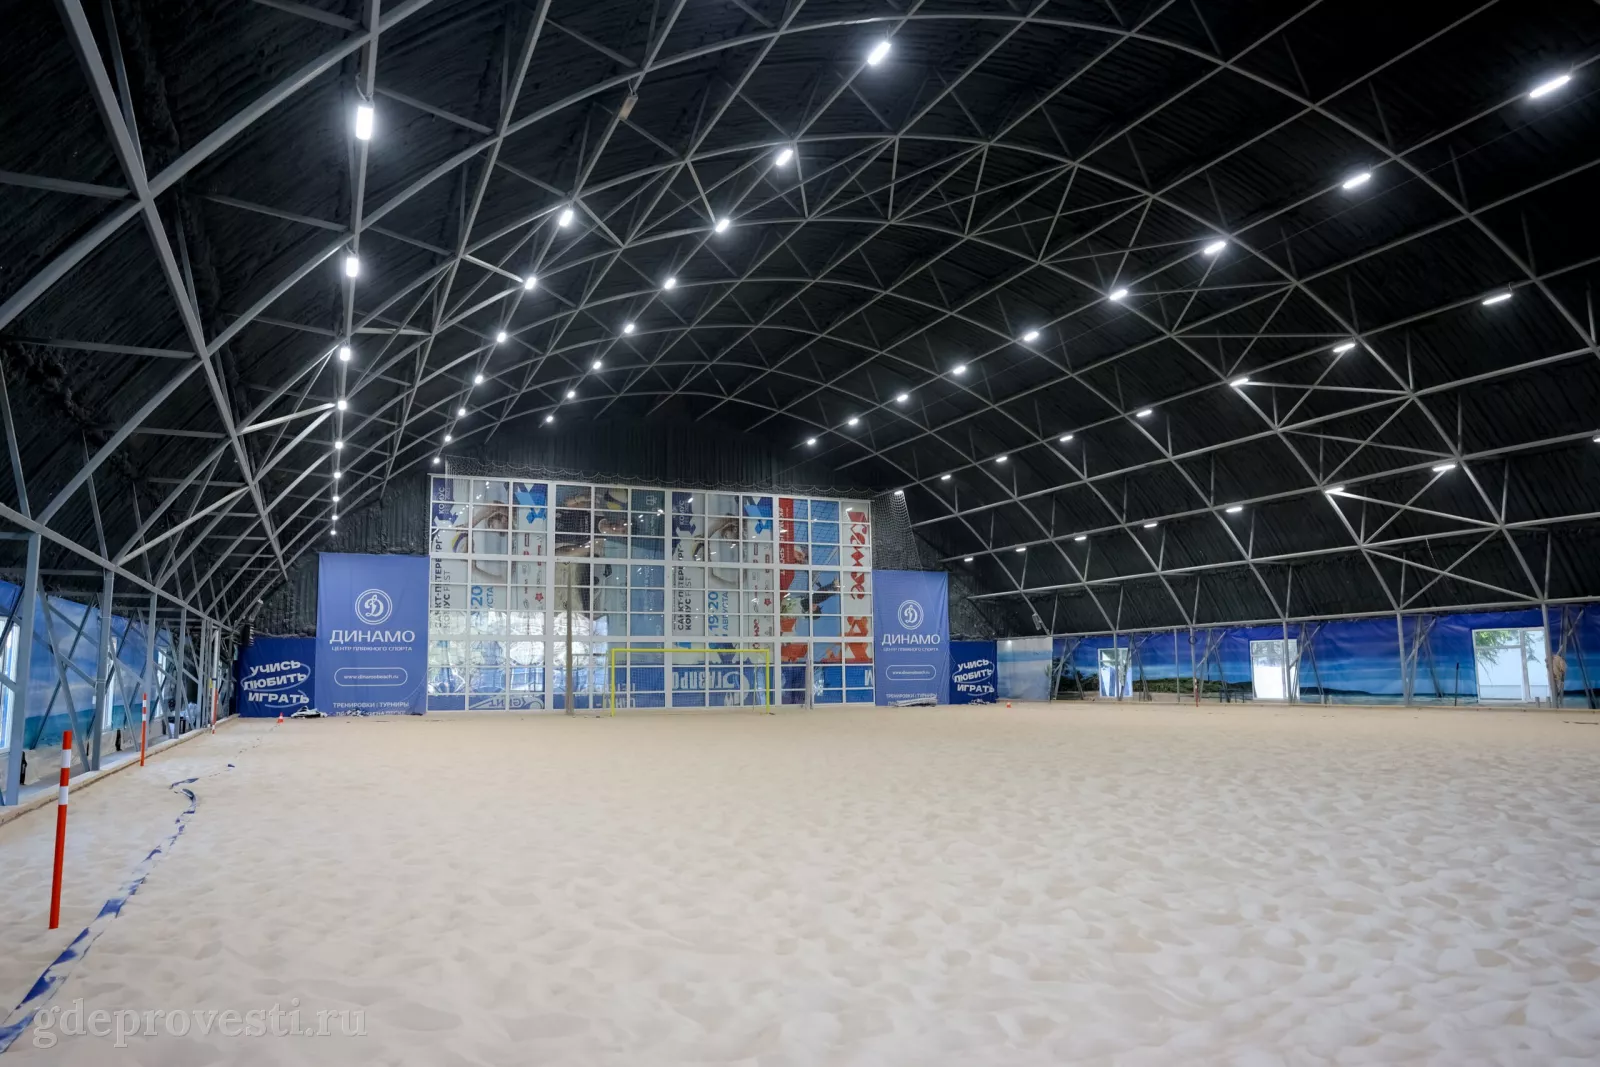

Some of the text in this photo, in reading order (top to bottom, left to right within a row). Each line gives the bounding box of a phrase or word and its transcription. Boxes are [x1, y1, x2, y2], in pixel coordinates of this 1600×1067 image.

[329, 629, 416, 645] ДИНАМО
[881, 633, 941, 646] ДИНАМО
[250, 660, 301, 676] УЧИСЬ
[957, 659, 990, 671] УЧИСЬ
[243, 673, 308, 691] ЛЮБИТЬ
[954, 669, 994, 683] ЛЮБИТЬ
[957, 683, 995, 693] ИГРАТЬ
[248, 692, 310, 704] ИГРАТЬ
